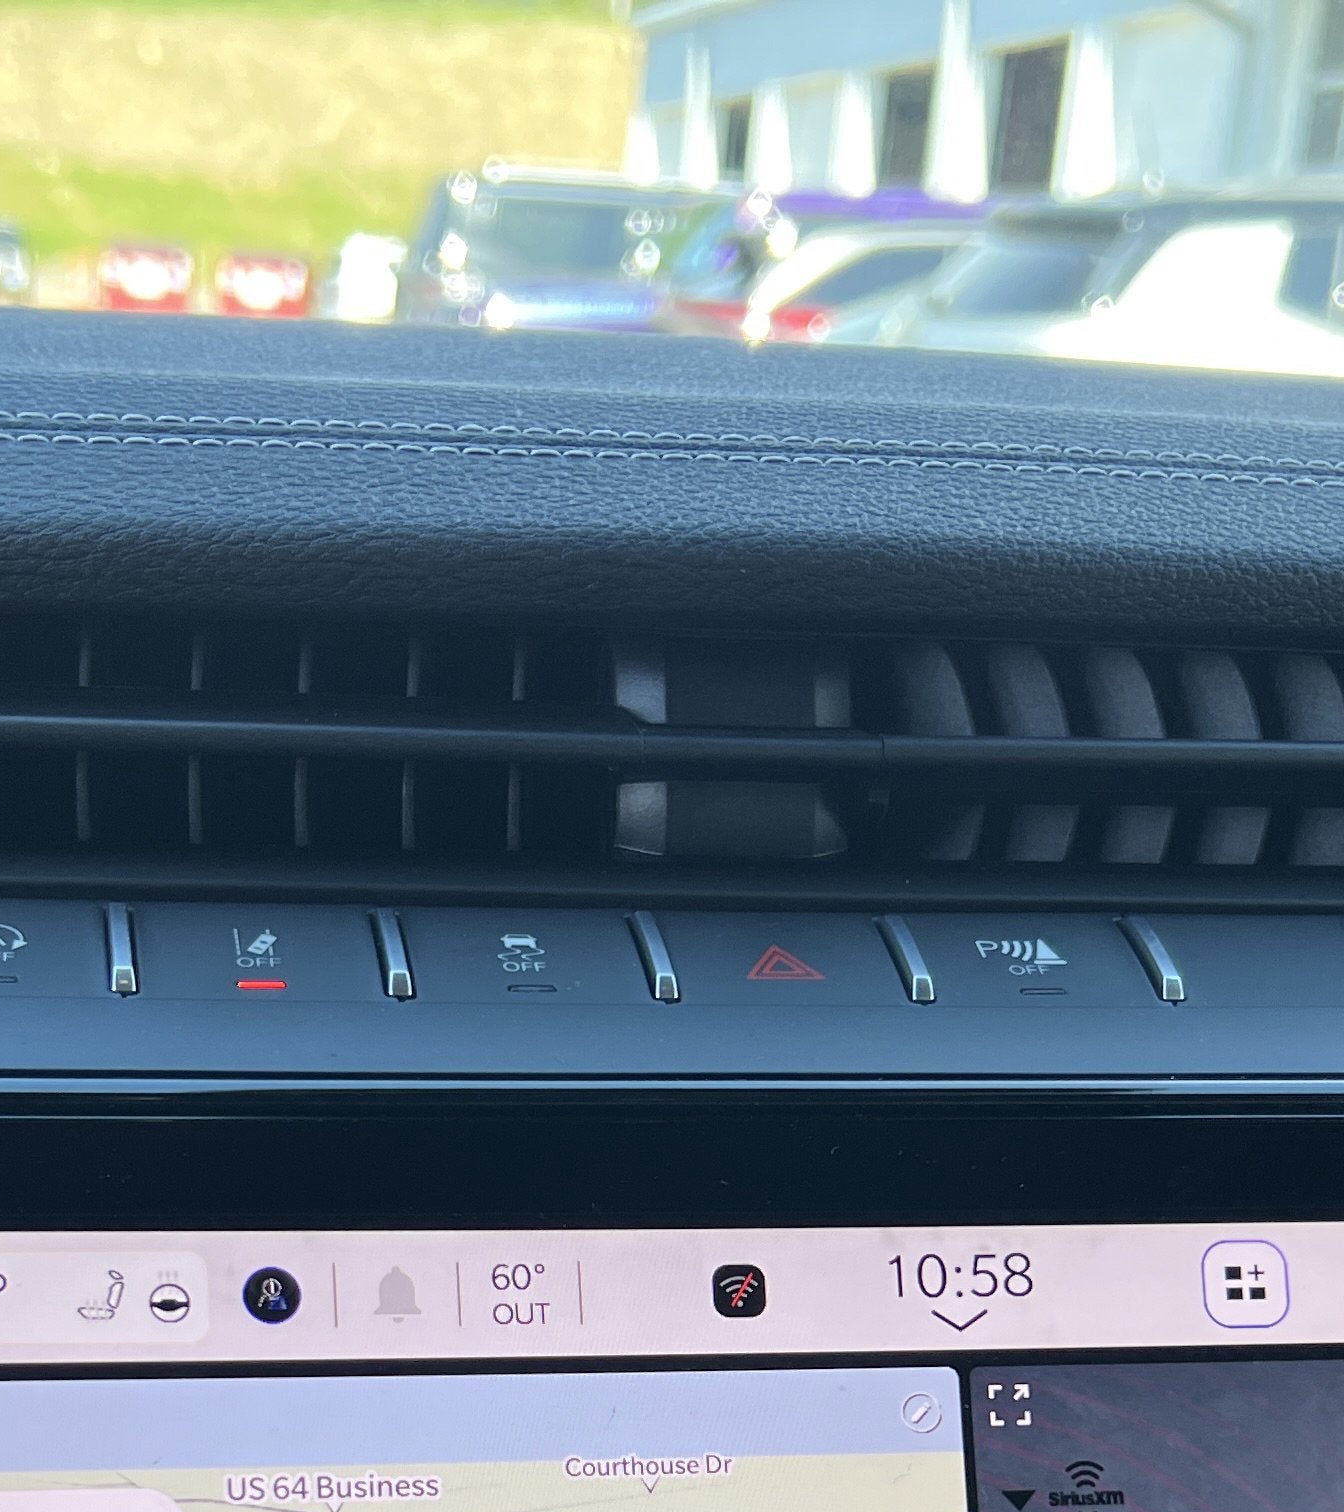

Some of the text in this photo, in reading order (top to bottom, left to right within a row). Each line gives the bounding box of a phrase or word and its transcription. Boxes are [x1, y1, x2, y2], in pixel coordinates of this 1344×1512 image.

[235, 956, 283, 969] OFF
[501, 960, 548, 974] OFF
[1008, 963, 1052, 977] OFF
[489, 1261, 547, 1293] 60°
[887, 1253, 1035, 1302] 10:58
[491, 1300, 551, 1326] OUT
[564, 1455, 734, 1480] Courthouse Dr
[225, 1473, 441, 1502] US 64 Business
